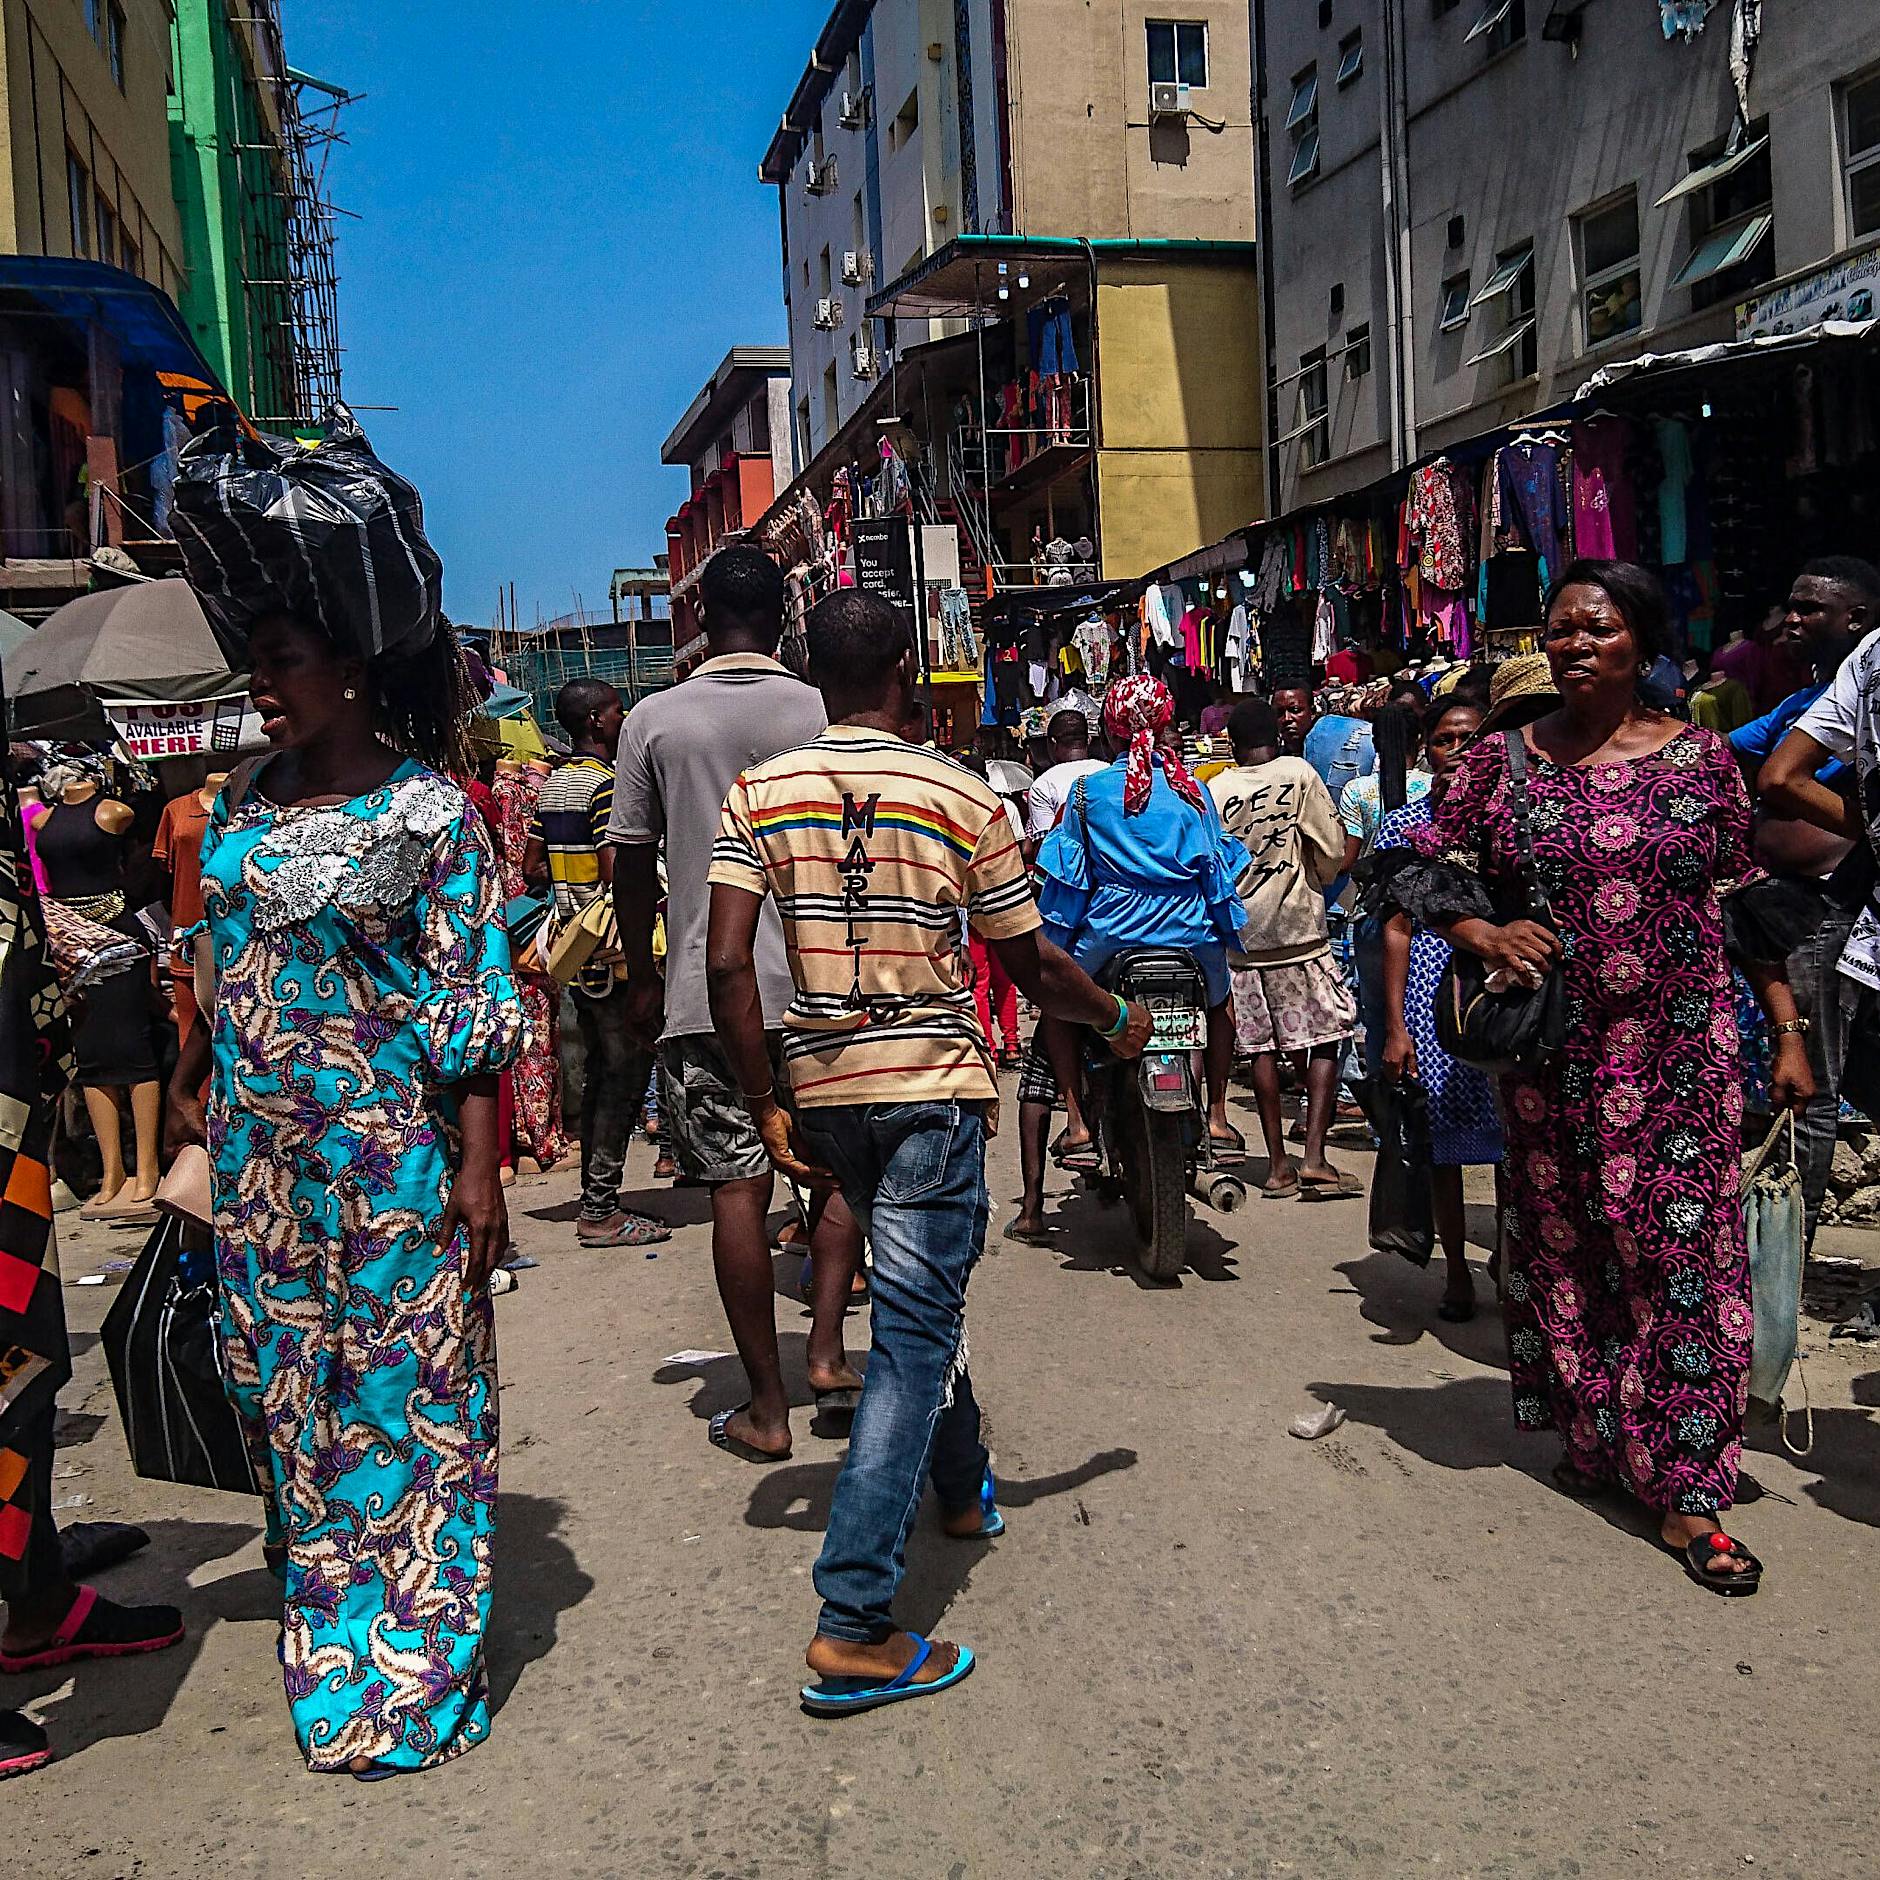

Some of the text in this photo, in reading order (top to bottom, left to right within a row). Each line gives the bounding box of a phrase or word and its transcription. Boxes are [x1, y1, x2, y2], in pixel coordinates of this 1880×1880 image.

[860, 558, 878, 568] You
[861, 568, 895, 579] accept
[125, 718, 204, 739] AVAILABLE
[129, 735, 204, 756] HERE
